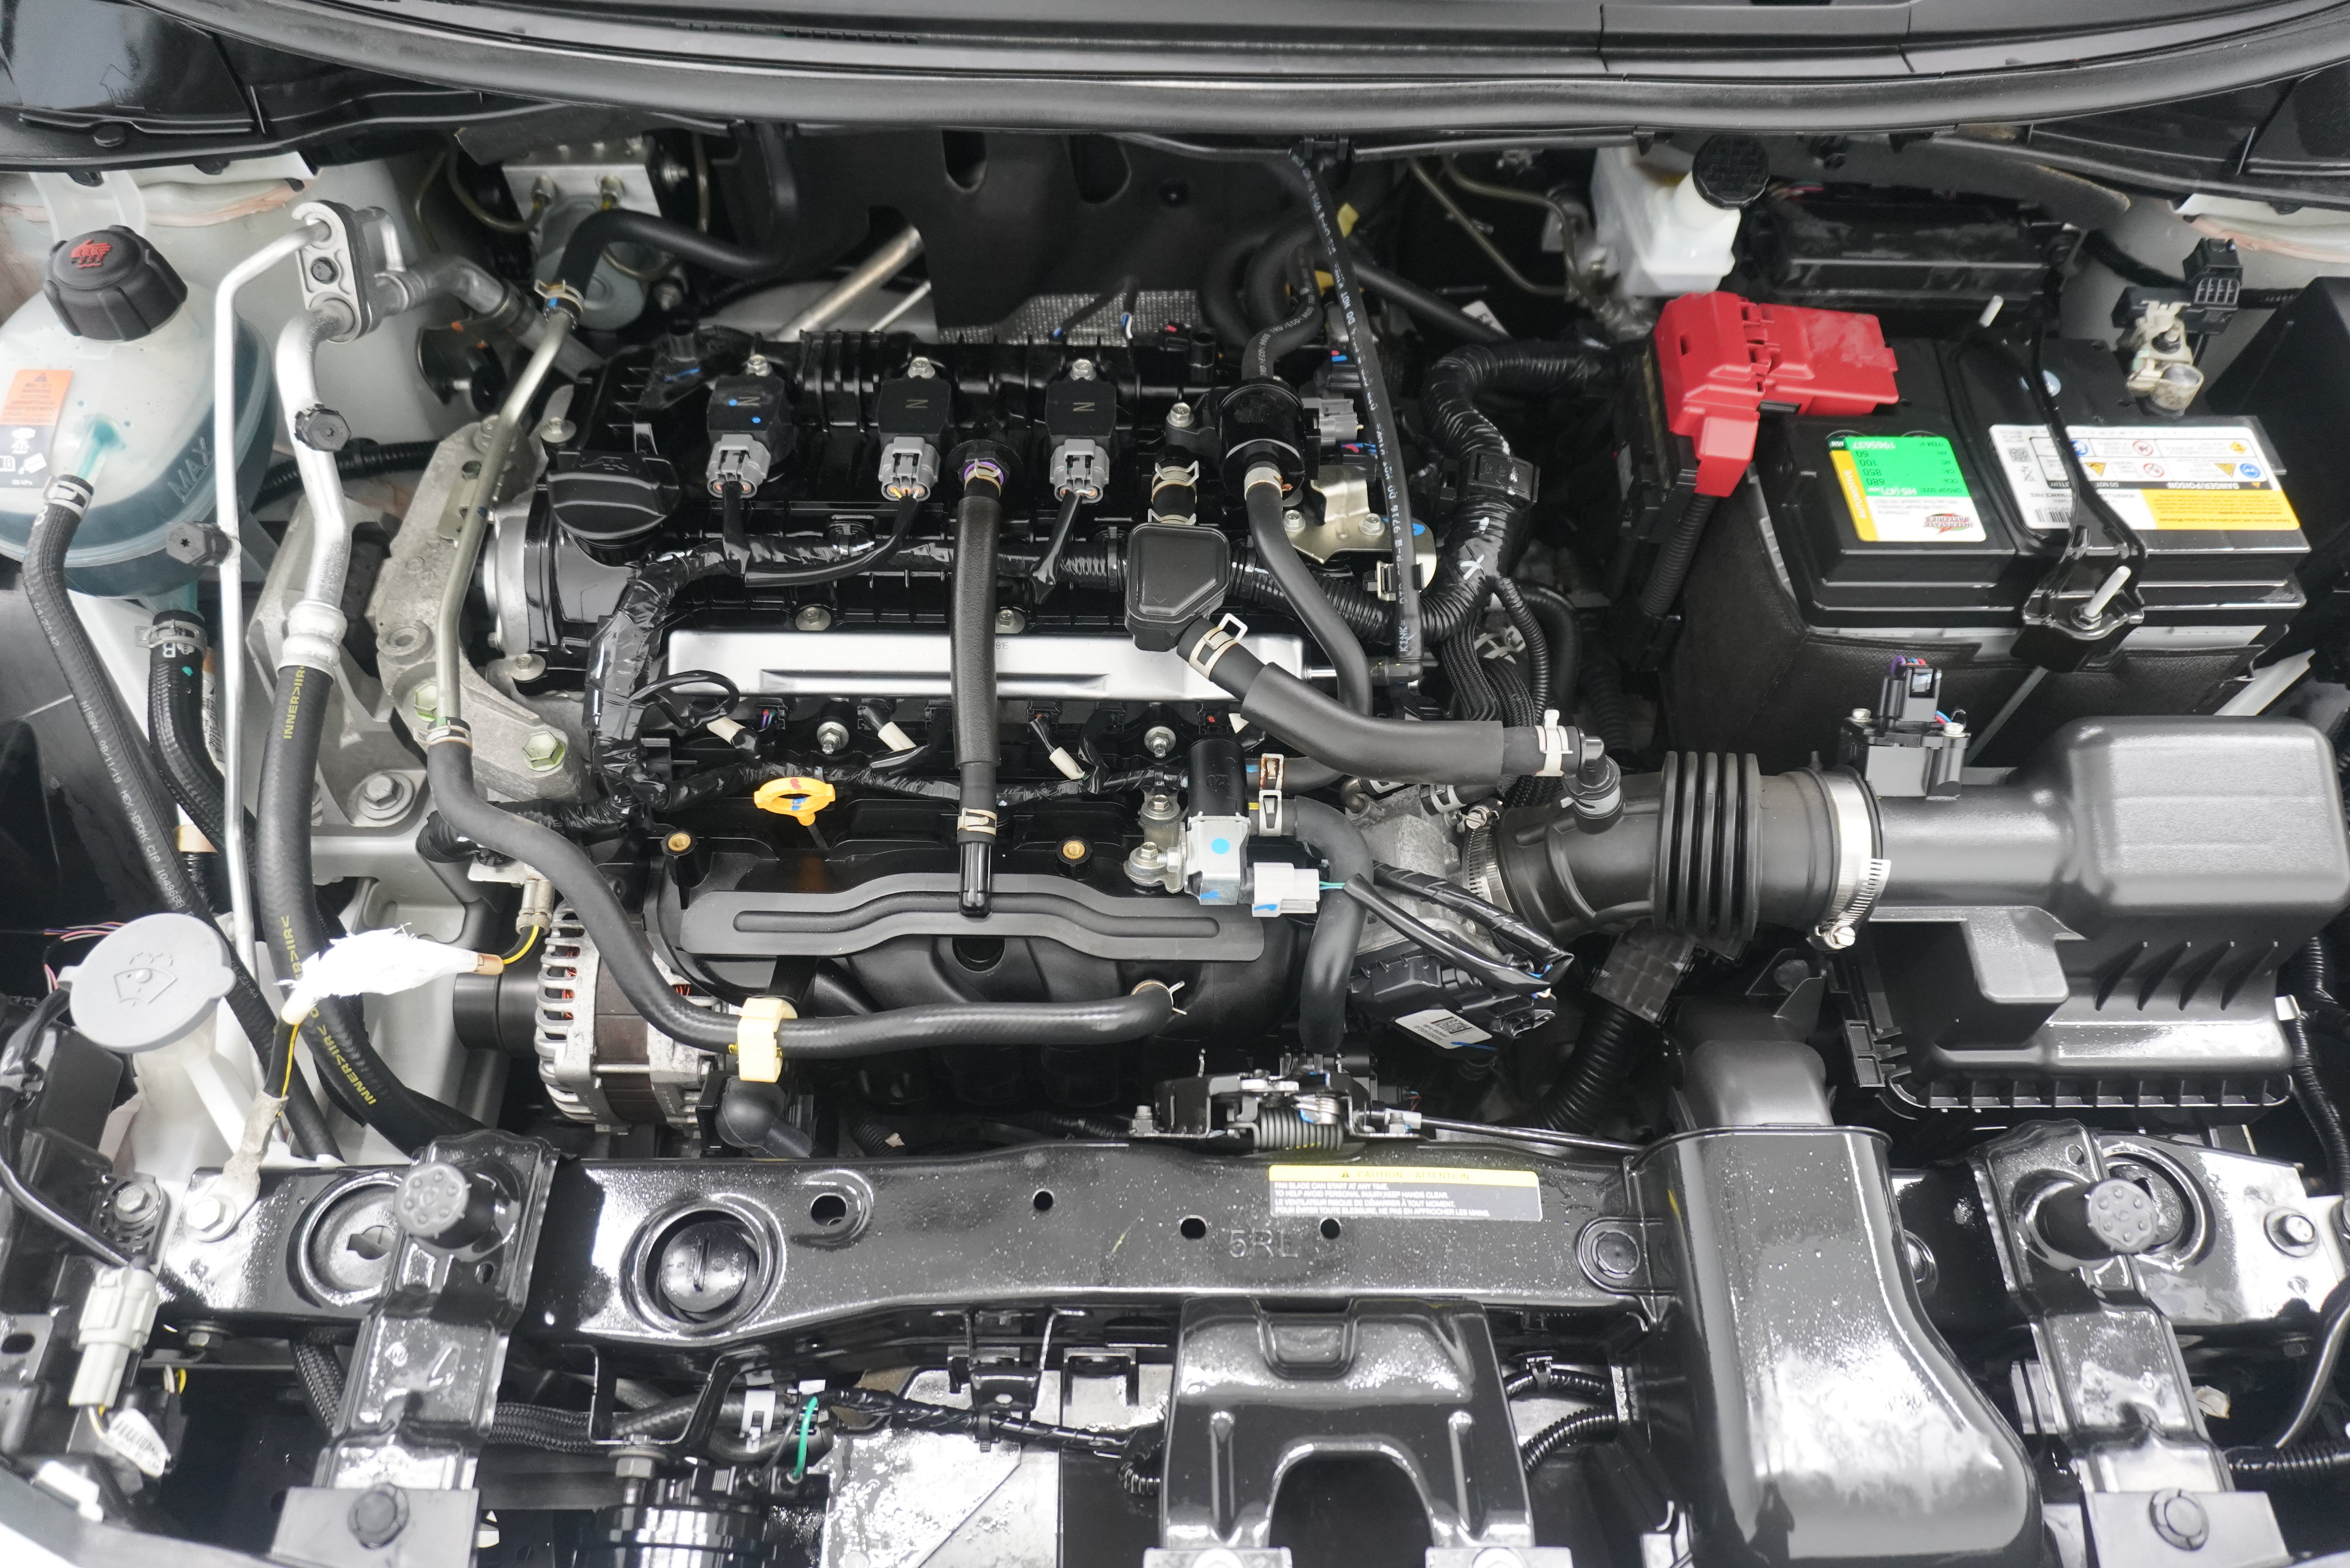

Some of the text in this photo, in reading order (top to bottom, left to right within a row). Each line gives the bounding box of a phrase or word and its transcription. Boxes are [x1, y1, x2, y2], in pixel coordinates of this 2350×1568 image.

[168, 437, 208, 504] MAX
[1844, 469, 1867, 518] AUTOMOTIVE
[1881, 486, 1900, 495] (47)
[81, 700, 100, 734] NISSAN
[146, 845, 161, 863] CIP
[1415, 1171, 1469, 1180] ATTENTION
